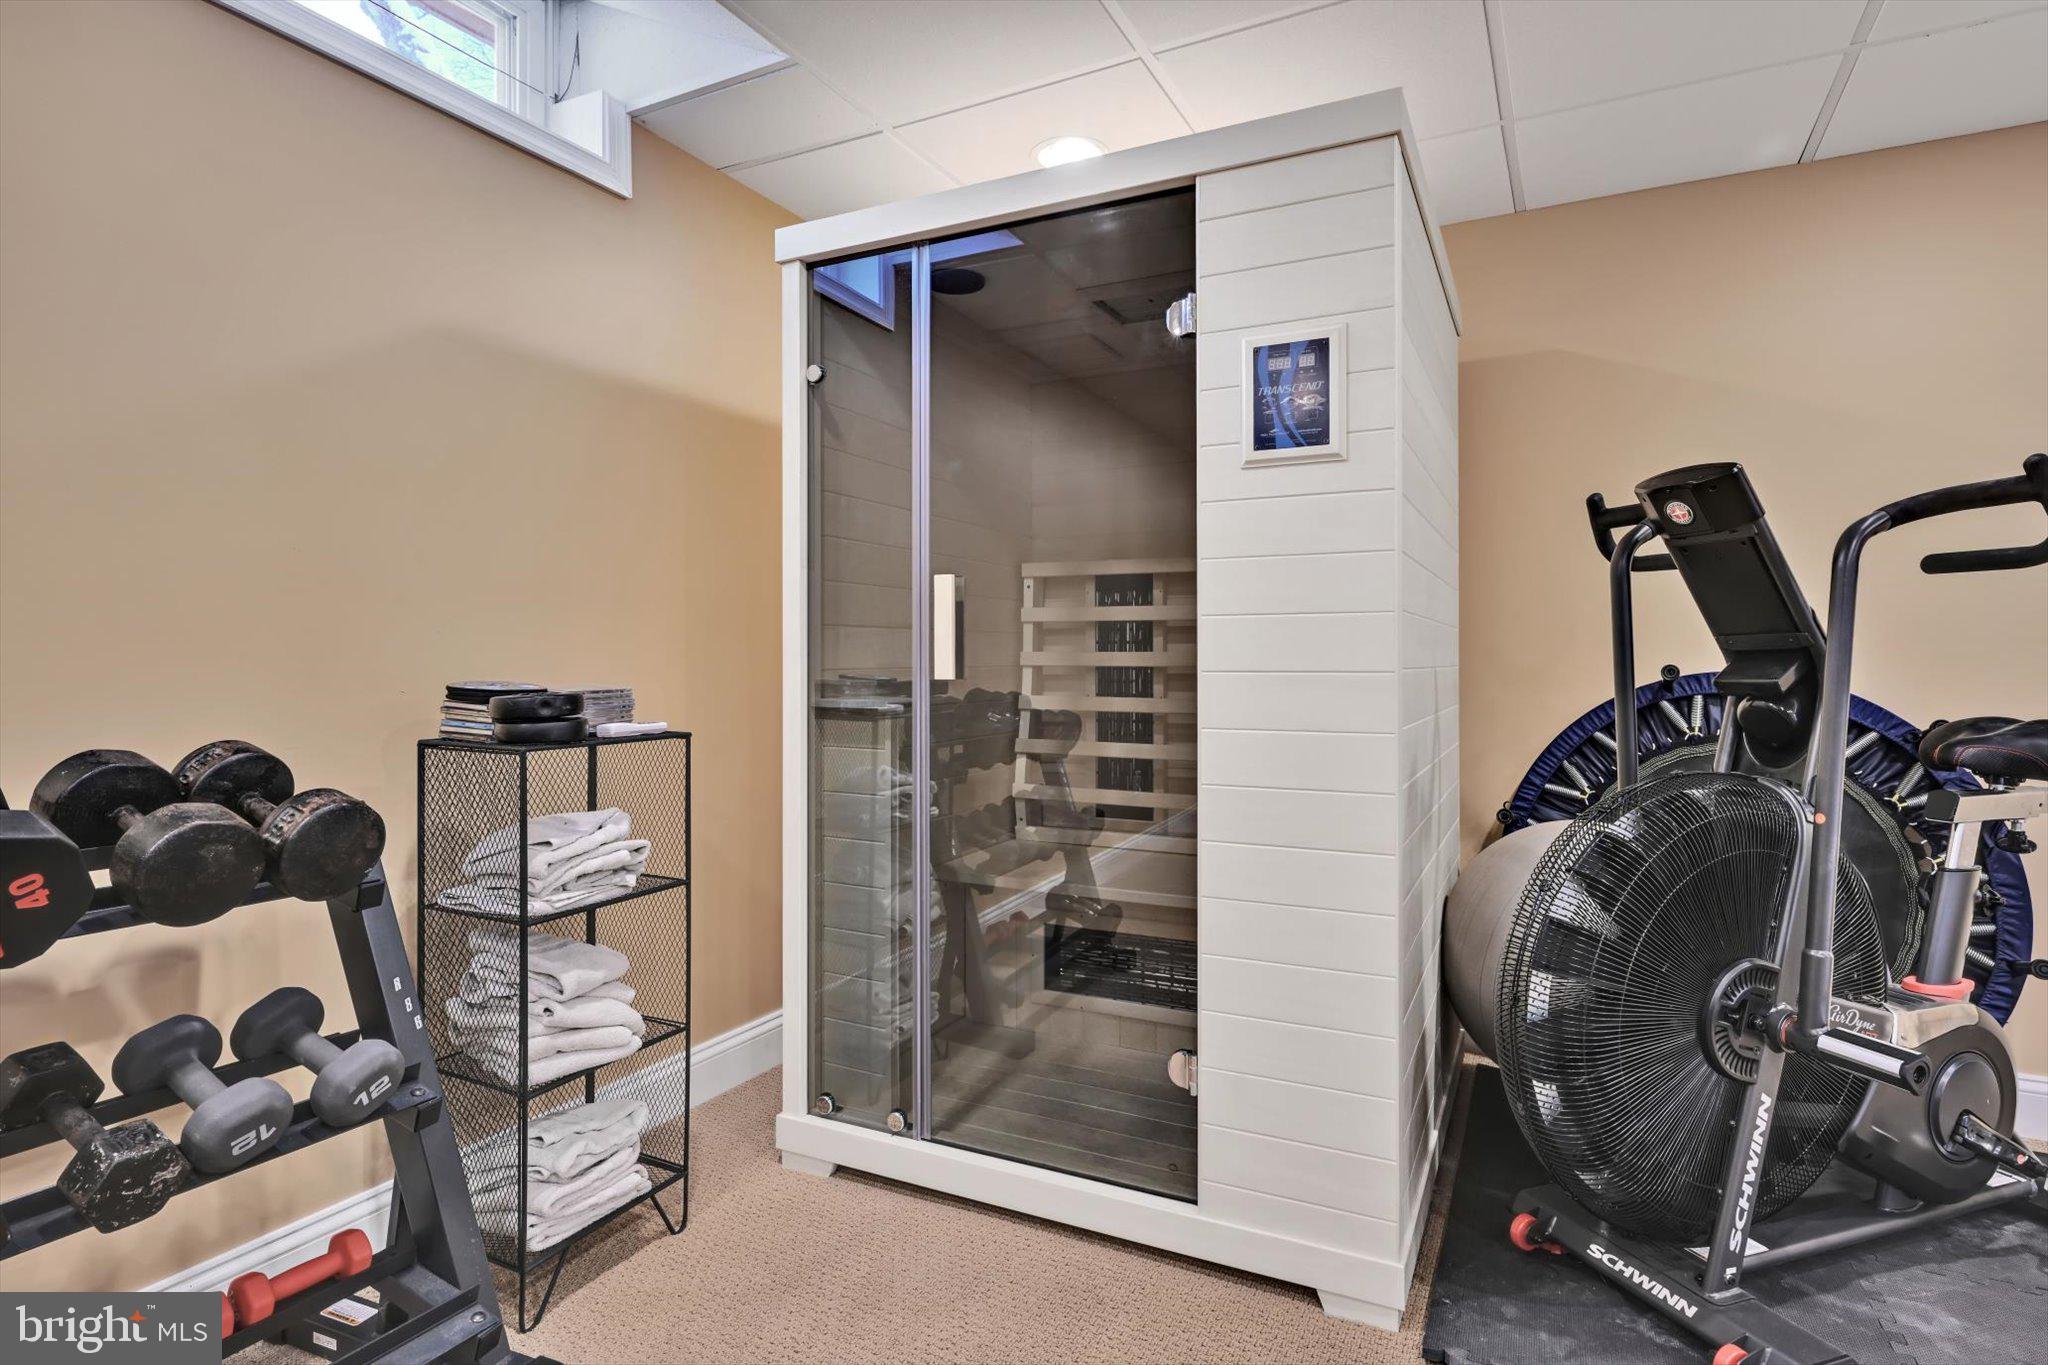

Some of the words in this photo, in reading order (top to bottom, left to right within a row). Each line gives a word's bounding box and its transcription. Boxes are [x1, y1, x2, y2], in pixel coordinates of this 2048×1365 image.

[1258, 381, 1322, 396] TRANSCEND
[9, 873, 50, 909] 40
[353, 1074, 392, 1106] 12
[230, 1123, 277, 1156] 12
[1729, 1092, 1772, 1254] SCHWINN
[1586, 1243, 1698, 1318] SCHWINN
